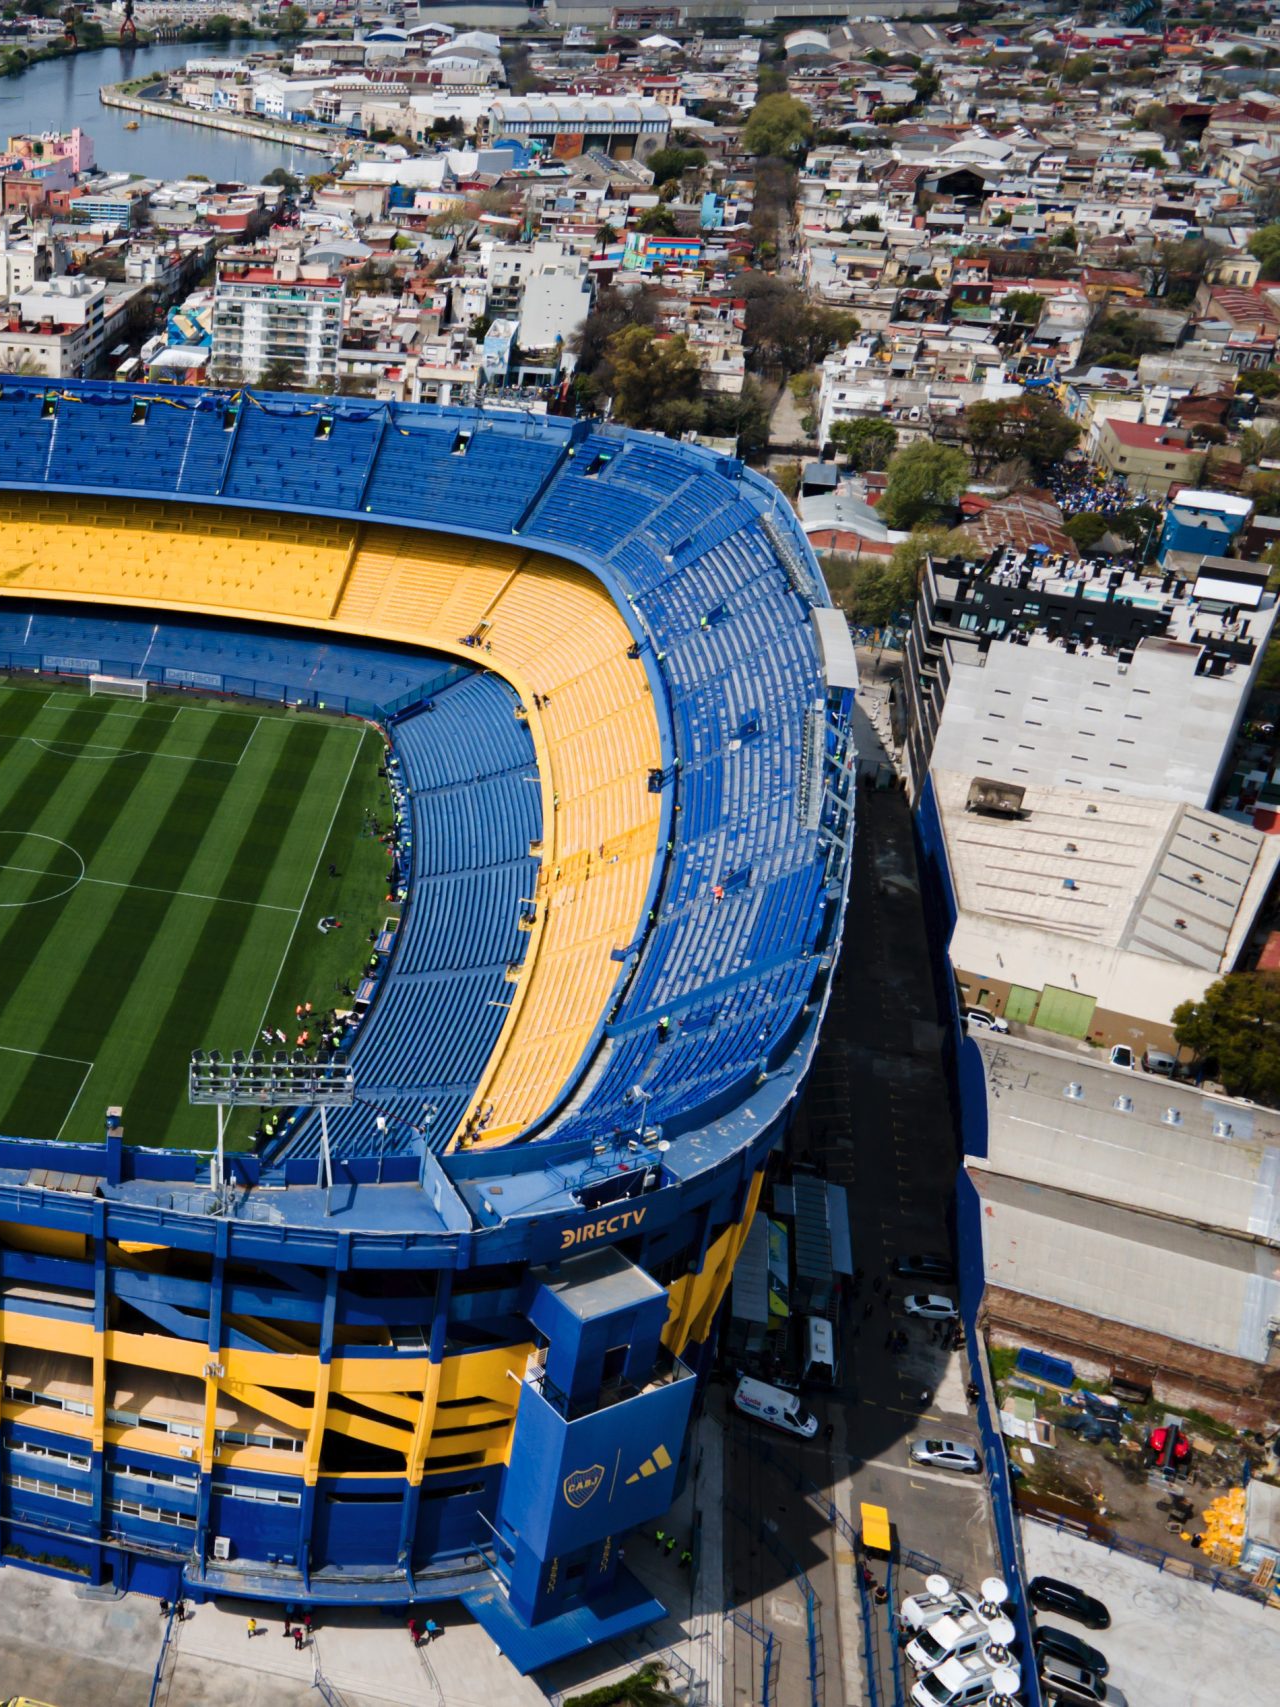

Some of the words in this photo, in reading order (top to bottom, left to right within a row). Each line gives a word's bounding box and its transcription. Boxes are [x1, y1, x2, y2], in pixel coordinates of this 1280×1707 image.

[46, 656, 98, 670] betsson
[168, 670, 217, 685] betsson
[560, 1207, 647, 1249] DIRECTV
[567, 1476, 599, 1493] CABJ
